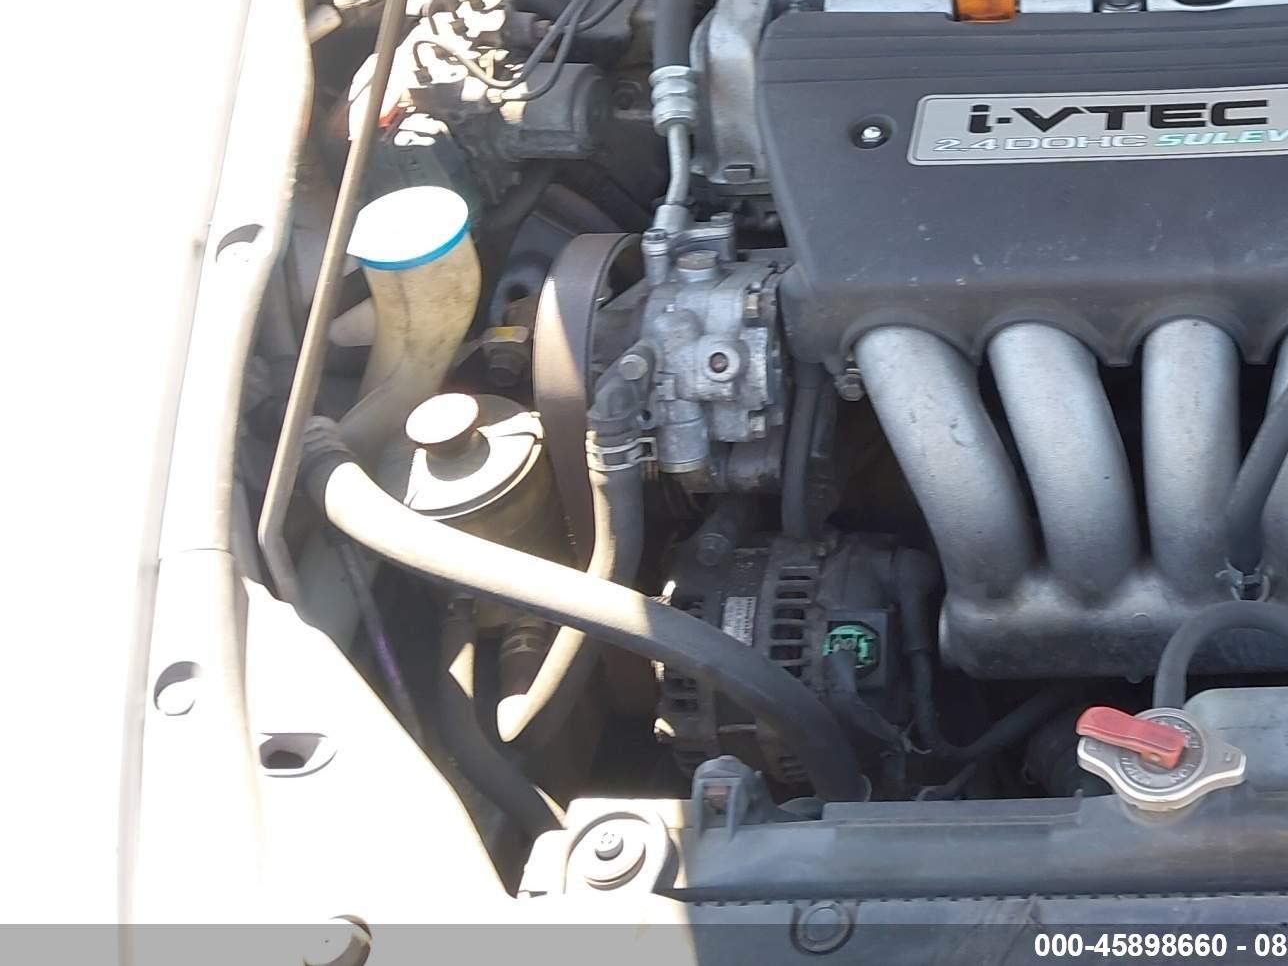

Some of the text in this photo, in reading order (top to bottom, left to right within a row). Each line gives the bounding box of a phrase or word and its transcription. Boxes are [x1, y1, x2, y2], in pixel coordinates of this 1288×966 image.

[969, 98, 1268, 134] i-VTEC
[933, 137, 999, 153] 2.4
[1003, 134, 1148, 151] DOHC
